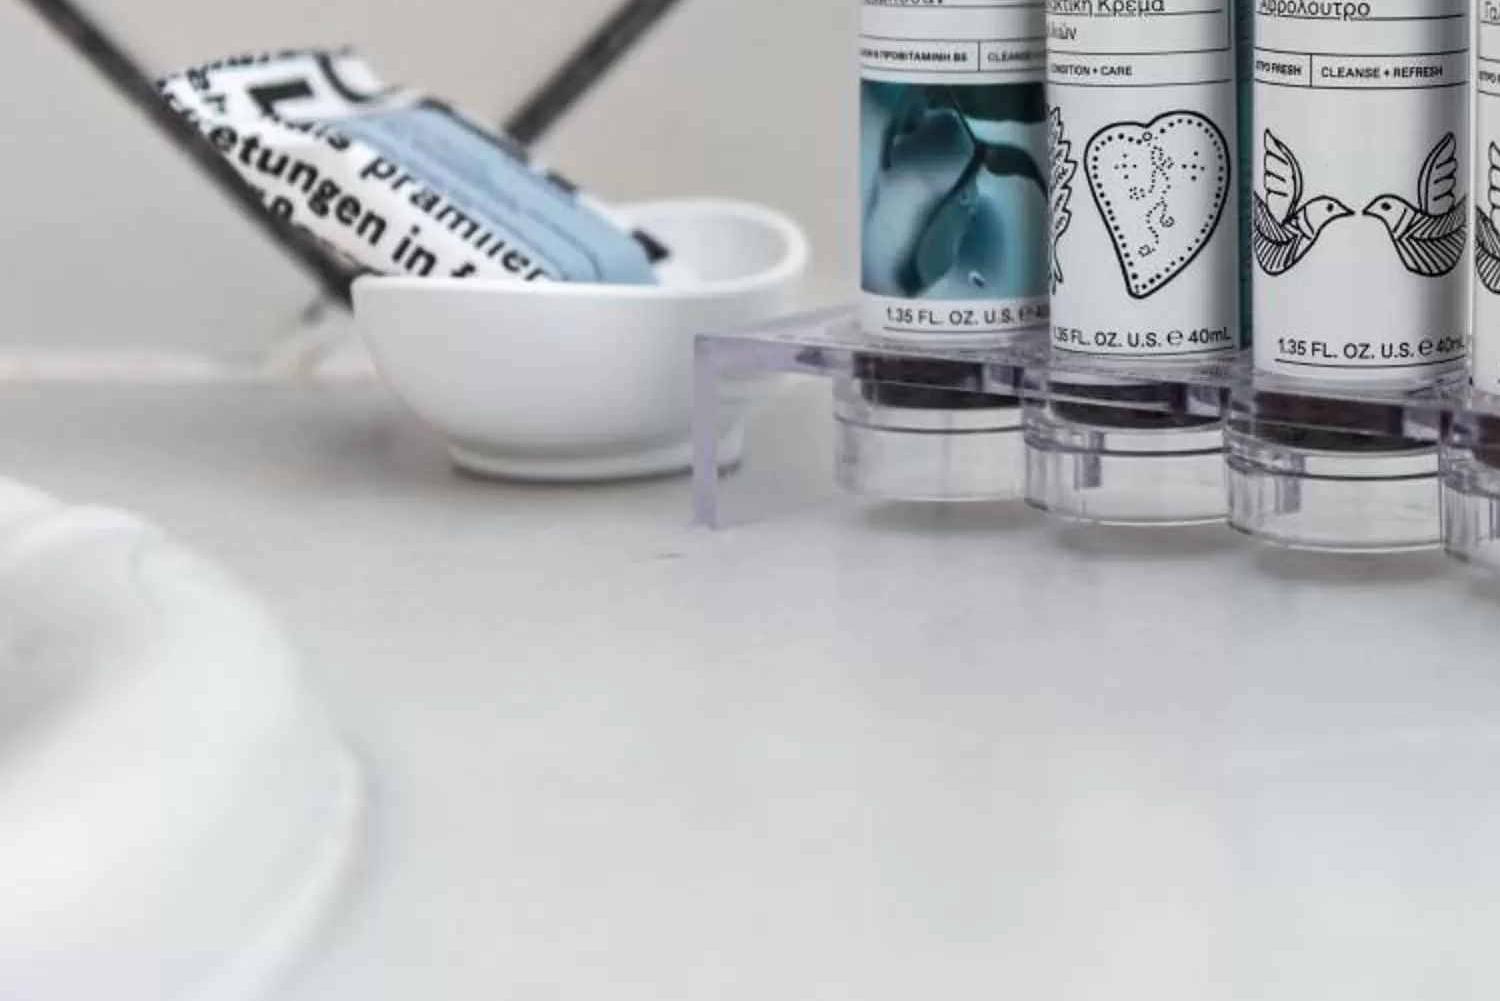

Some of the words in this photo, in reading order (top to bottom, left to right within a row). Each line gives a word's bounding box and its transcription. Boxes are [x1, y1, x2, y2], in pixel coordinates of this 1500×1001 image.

[1100, 65, 1133, 76] CARE
[1321, 66, 1381, 78] CLEANSE
[1393, 64, 1443, 78] REFRESH
[208, 125, 388, 247] etungen
[391, 224, 437, 278] in
[949, 310, 979, 327] OZ.
[1094, 331, 1122, 348] OZ.
[1127, 331, 1162, 348] U.S.
[1188, 326, 1232, 345] 40mL
[1279, 337, 1307, 356] 1.35
[1311, 340, 1338, 359] FL.
[1343, 342, 1375, 360] OZ.
[1381, 341, 1415, 360] U.S.
